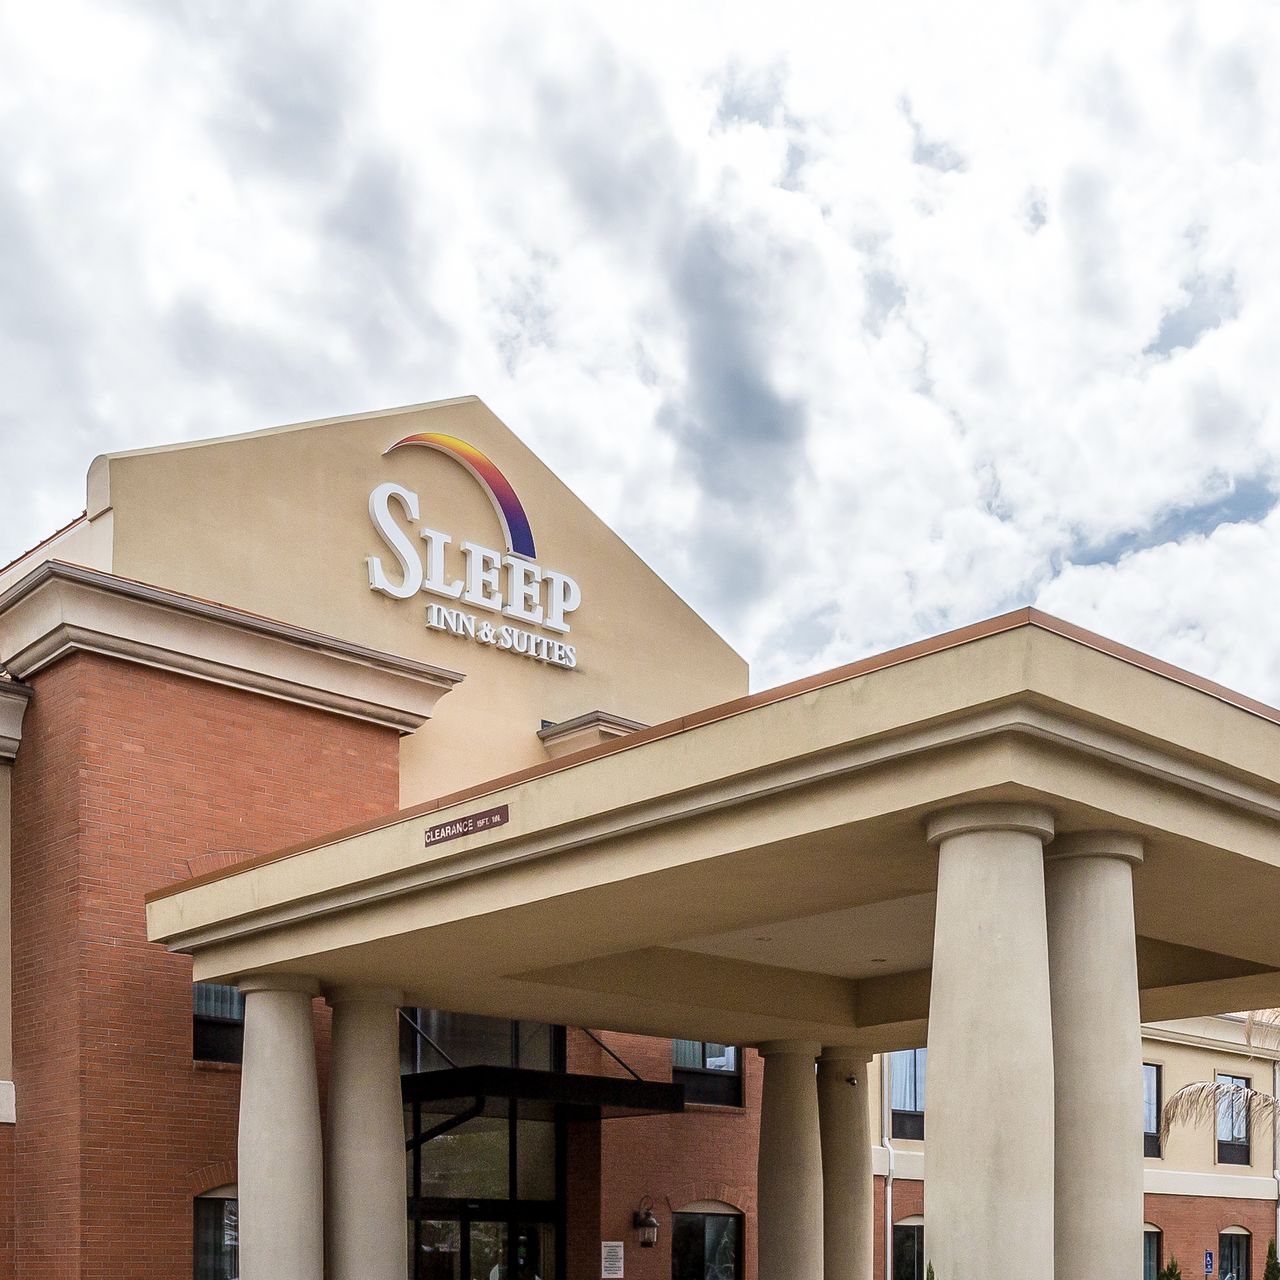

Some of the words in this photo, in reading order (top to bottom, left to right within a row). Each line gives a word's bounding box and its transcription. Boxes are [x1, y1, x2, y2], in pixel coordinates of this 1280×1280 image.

[367, 483, 581, 633] SLEEP
[426, 603, 475, 638] INN
[477, 622, 495, 644] &
[496, 626, 577, 669] SUITES
[425, 820, 473, 843] CLEARANCE
